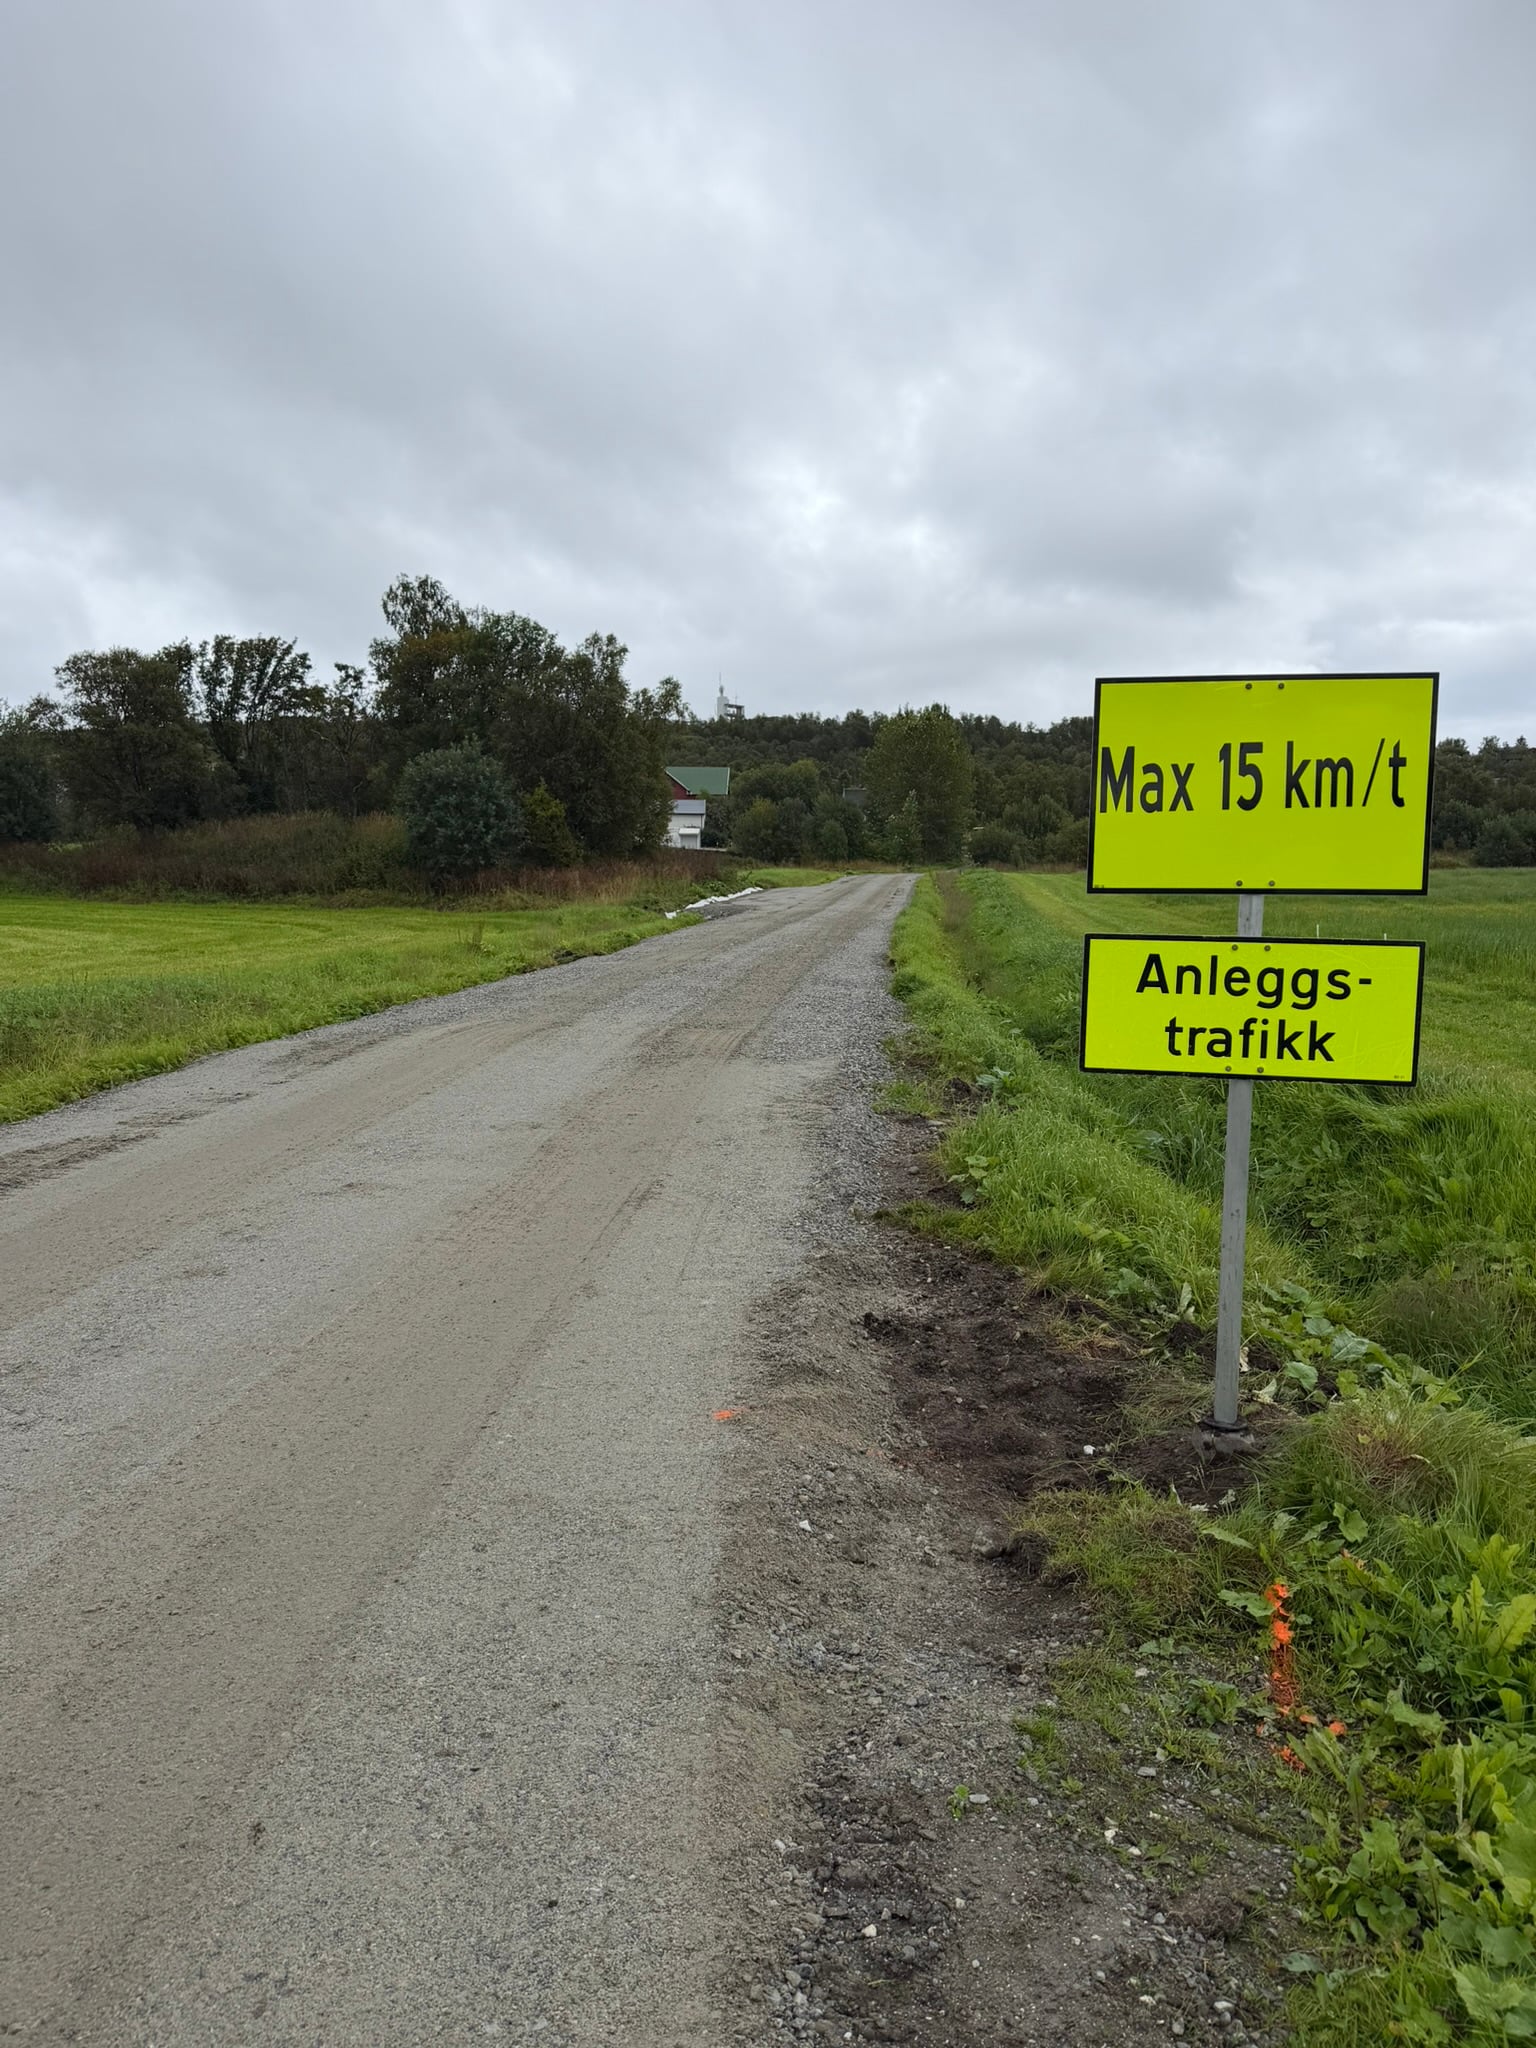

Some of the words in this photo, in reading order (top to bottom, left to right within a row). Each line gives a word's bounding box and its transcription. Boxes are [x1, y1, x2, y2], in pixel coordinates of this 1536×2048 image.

[1101, 745, 1195, 813] Max
[1219, 741, 1264, 811] 15
[1285, 738, 1407, 811] km/t
[1136, 953, 1372, 1010] Anleggs-
[1165, 1016, 1336, 1062] trafikk
